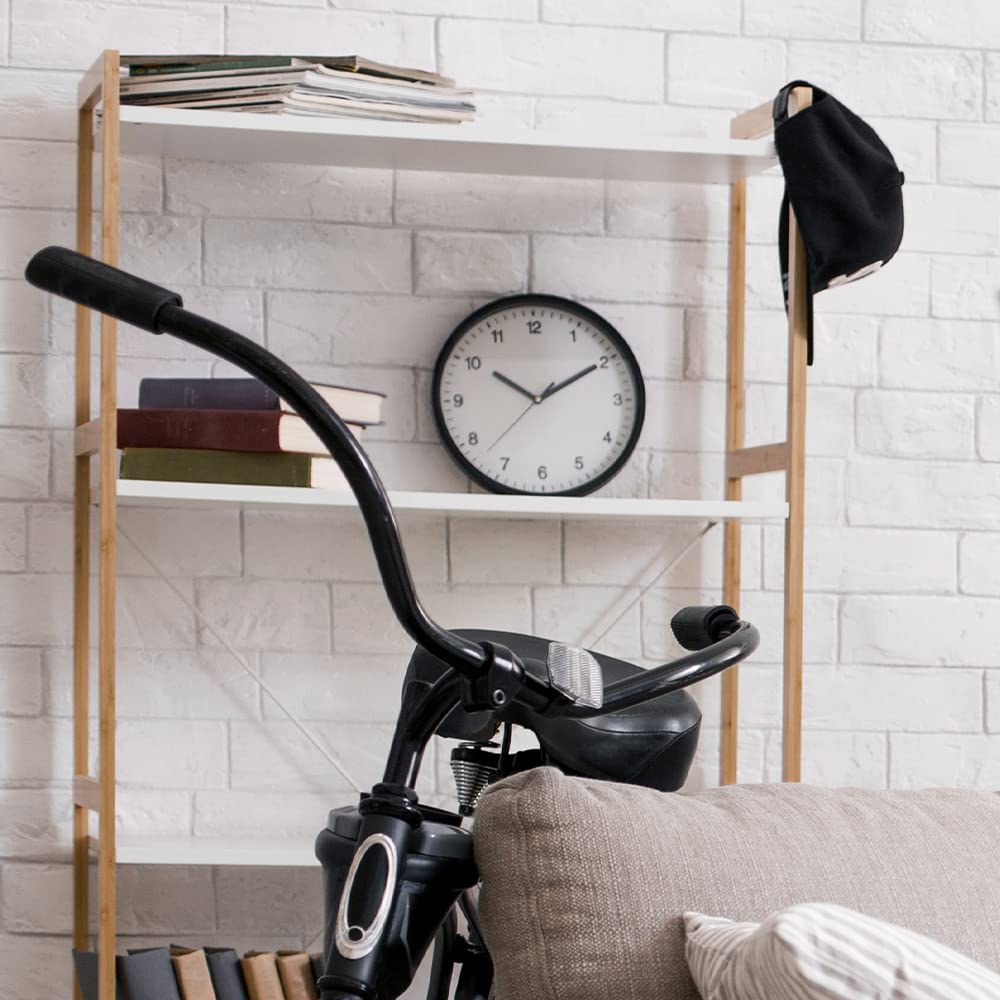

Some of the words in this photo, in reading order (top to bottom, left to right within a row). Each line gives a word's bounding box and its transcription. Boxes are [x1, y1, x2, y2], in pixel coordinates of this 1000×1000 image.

[527, 320, 542, 334] 12
[492, 331, 503, 343] 11
[570, 331, 576, 342] 1
[465, 356, 481, 370] 10
[600, 358, 609, 369] 2
[453, 394, 463, 408] 9
[613, 394, 623, 406] 3
[468, 432, 478, 446] 8
[603, 432, 612, 443] 4
[500, 457, 510, 470] 7
[574, 457, 584, 470] 5
[537, 466, 548, 480] 6
